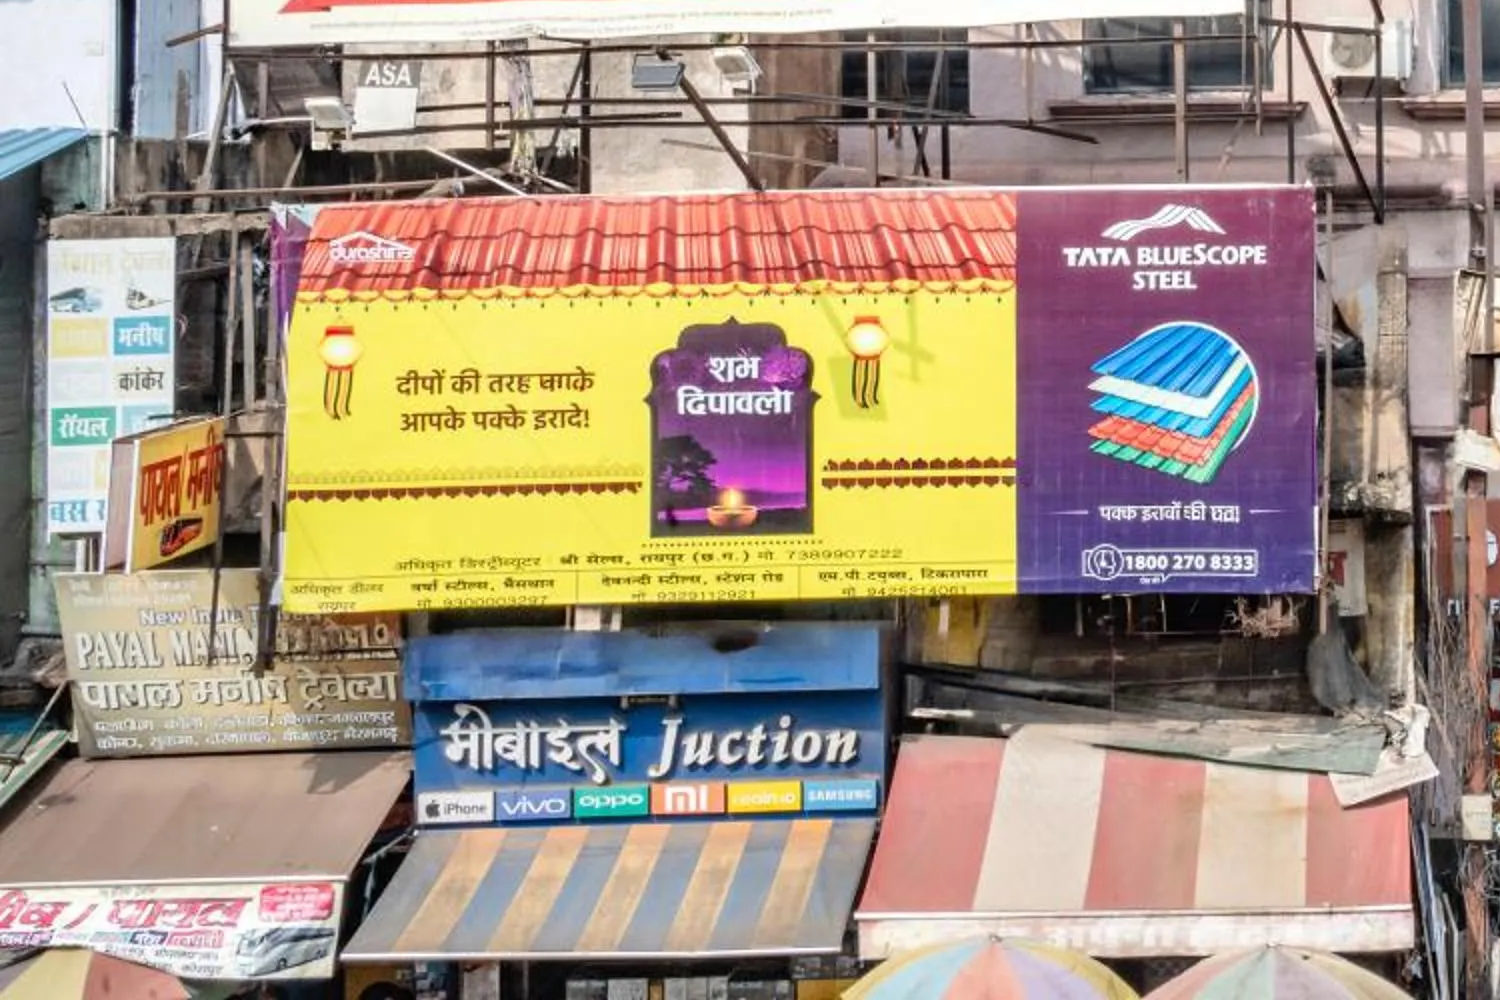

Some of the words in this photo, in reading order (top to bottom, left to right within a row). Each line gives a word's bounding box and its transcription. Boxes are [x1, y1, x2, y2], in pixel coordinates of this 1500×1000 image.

[364, 62, 414, 87] ASA
[1062, 246, 1131, 268] TATA
[1131, 270, 1198, 291] STEEL
[396, 369, 446, 396] दीपों
[451, 367, 482, 395] की
[487, 373, 532, 394] तरह
[400, 405, 466, 432] आपके
[472, 404, 527, 431] पक्के
[533, 403, 591, 431] इरादे!
[1125, 554, 1169, 571] 1800
[1172, 554, 1206, 571] 270
[1209, 554, 1254, 571] 8333
[140, 609, 186, 626] New
[76, 630, 163, 671] PAYAL
[441, 704, 627, 785] मोबाइल
[648, 714, 858, 778] Juction
[443, 801, 487, 817] iPhone
[500, 798, 567, 817] vivo
[807, 788, 874, 802] SAMSUNG
